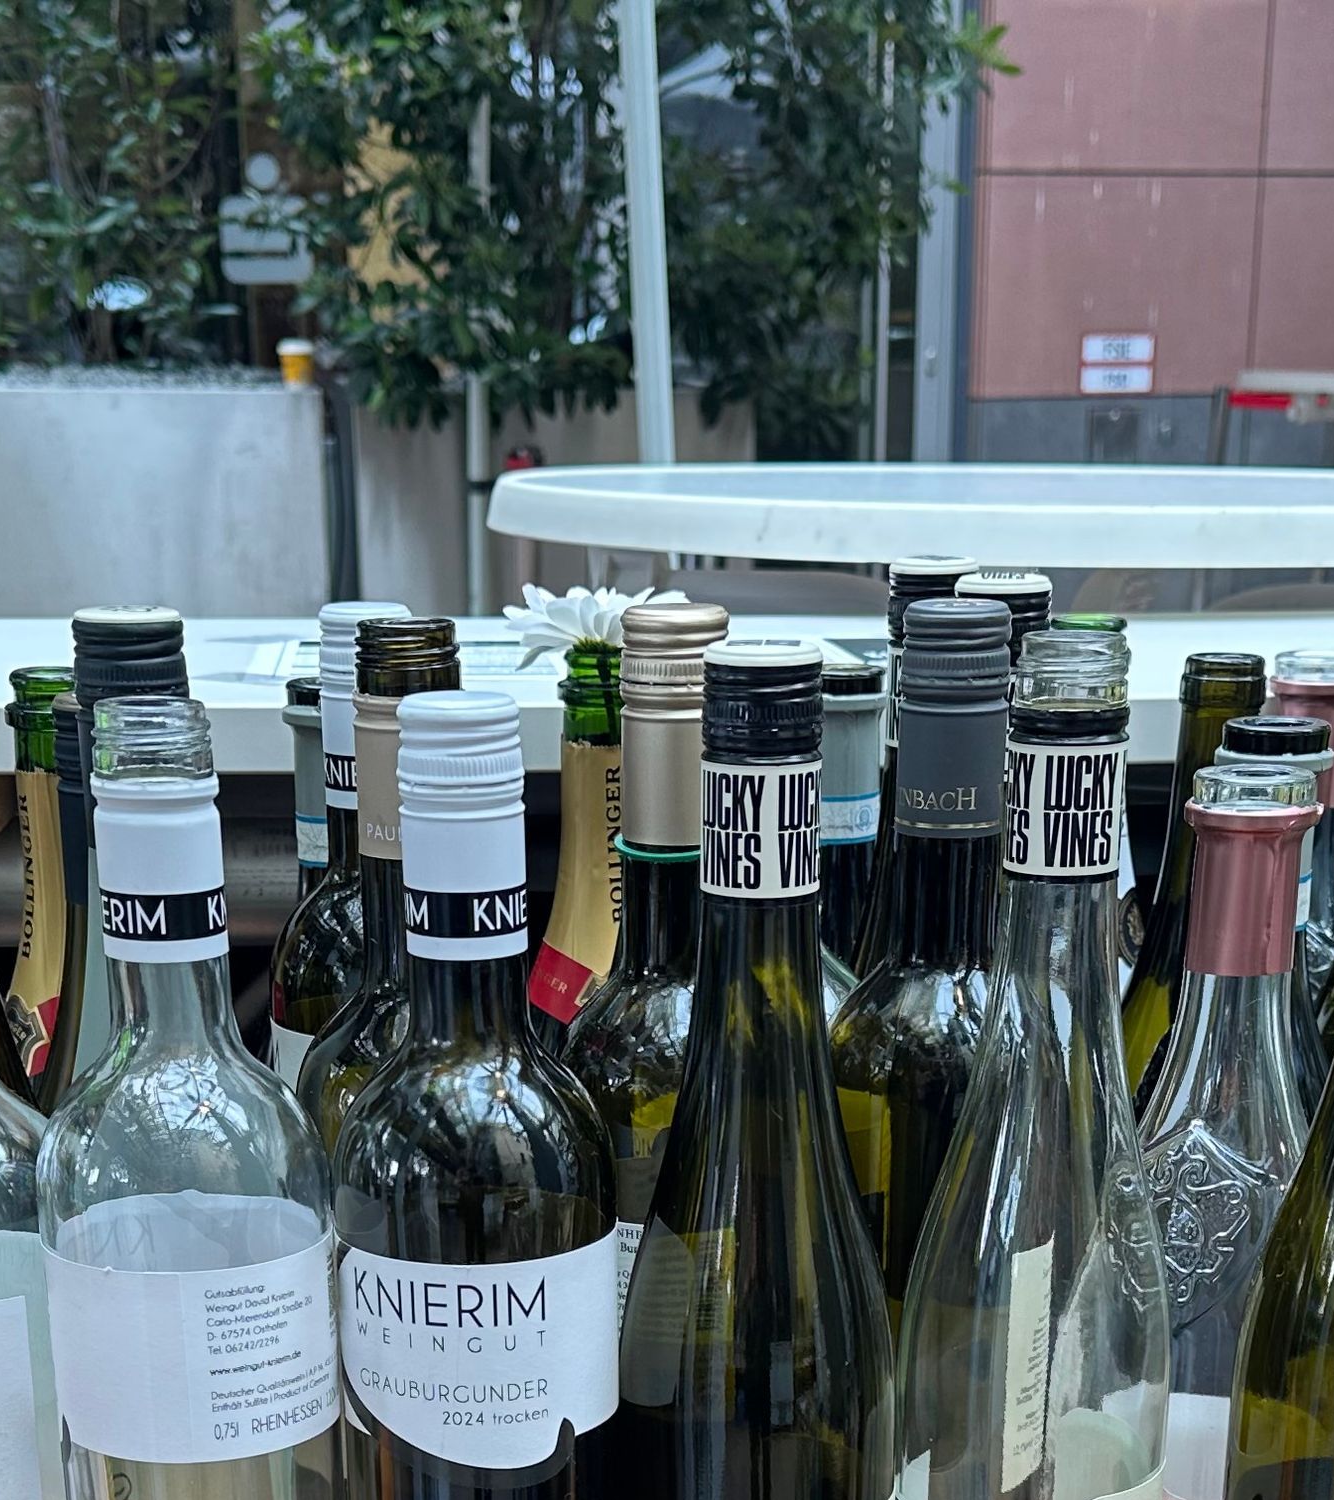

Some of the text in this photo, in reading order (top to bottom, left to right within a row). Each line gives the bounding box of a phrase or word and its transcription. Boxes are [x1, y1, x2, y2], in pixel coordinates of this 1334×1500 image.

[324, 756, 358, 790] KNIE
[1044, 753, 1119, 811] LUCKY
[702, 774, 766, 831] LUCKY
[899, 786, 978, 812] NBACH
[1043, 810, 1114, 868] VINES
[19, 794, 36, 959] BOLLINGER
[702, 832, 762, 890] VINES
[101, 898, 166, 935] ERIM
[472, 888, 527, 932] KNIE
[205, 1303, 243, 1313] Weingut
[304, 1295, 312, 1307] 20
[354, 1265, 547, 1329] KNIERIM
[221, 1328, 250, 1340] 67574
[225, 1335, 280, 1353] 06242/2296
[356, 1319, 547, 1353] WEINGUT
[211, 1388, 255, 1400] Deutscher
[274, 1387, 301, 1401] Product
[360, 1367, 549, 1405] GRAUBURGUNDER
[251, 1396, 323, 1435] RHEINHESSEN
[442, 1405, 550, 1426] 2024 trocken
